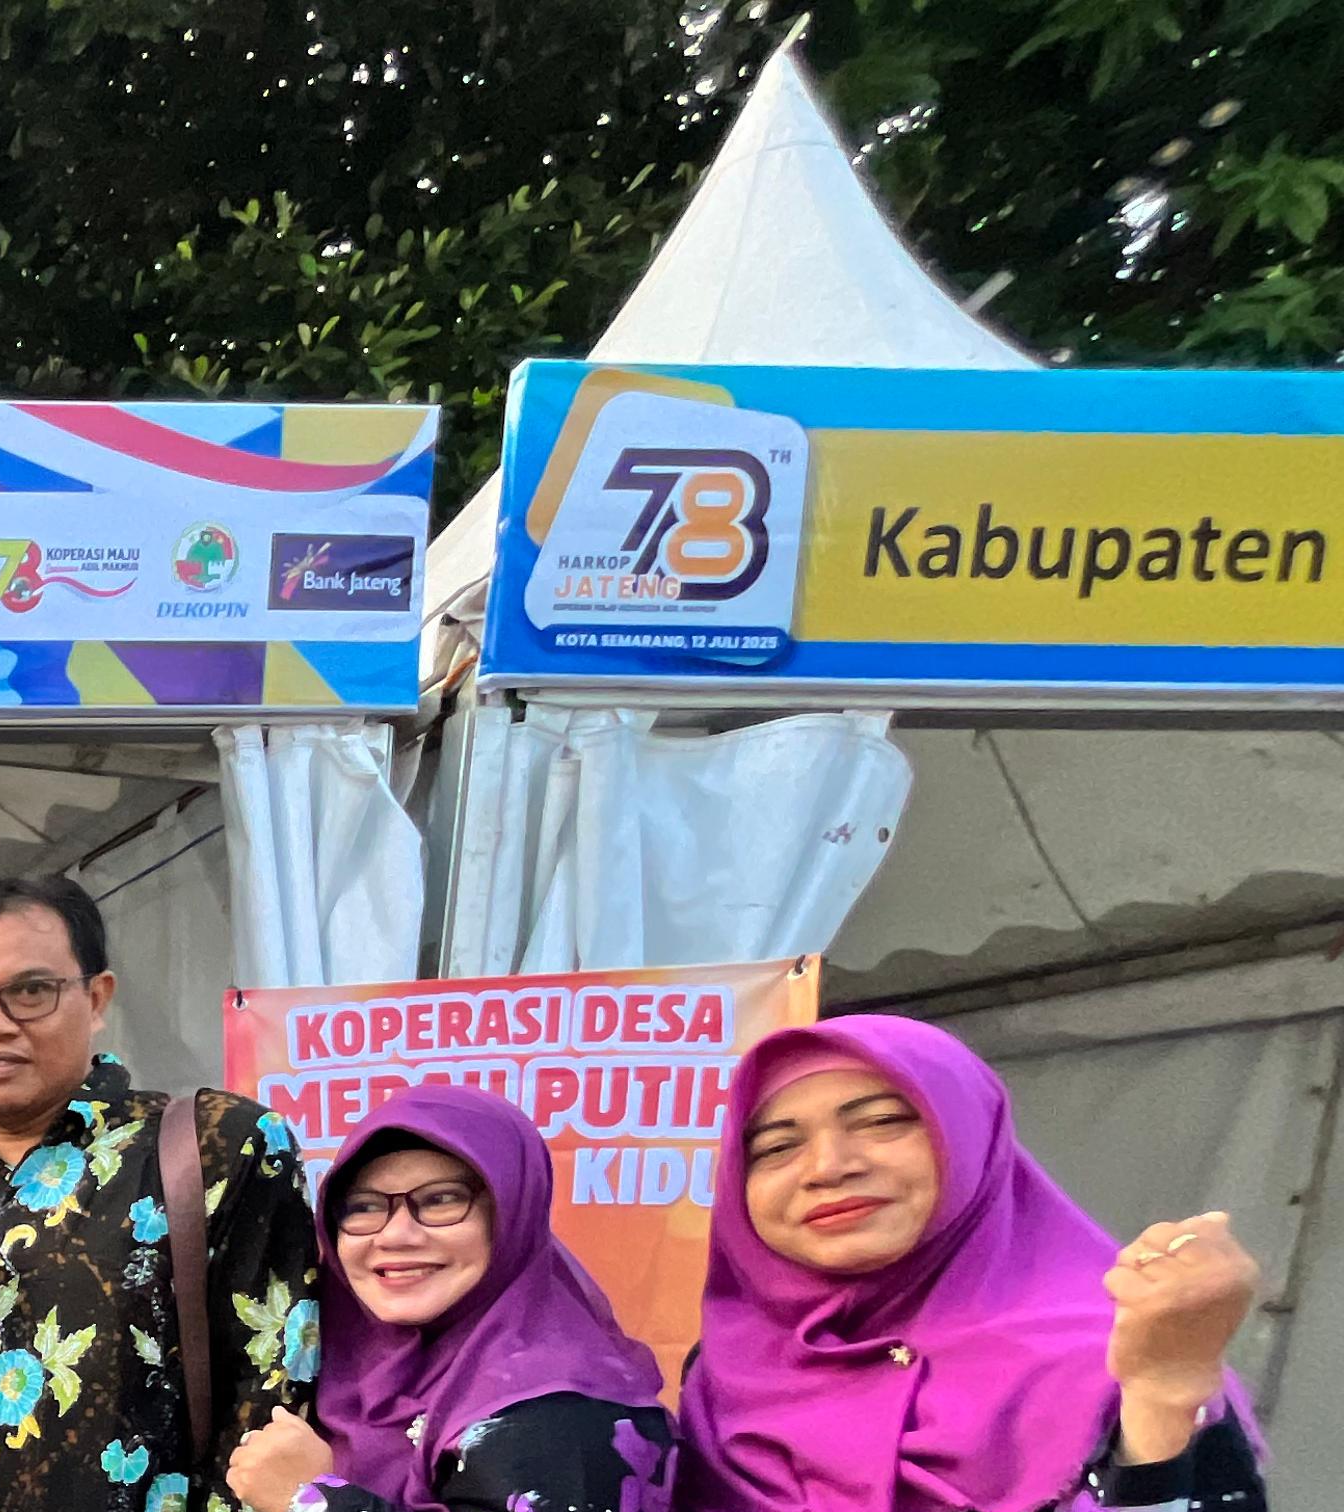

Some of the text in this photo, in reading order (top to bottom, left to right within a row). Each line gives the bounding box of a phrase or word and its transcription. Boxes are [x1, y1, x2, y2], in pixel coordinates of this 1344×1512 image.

[768, 449, 792, 464] TH
[602, 447, 772, 601] 78
[46, 547, 140, 561] KOPERASI MAJU
[863, 503, 1326, 599] Kabupaten
[558, 556, 631, 570] HARKOP
[303, 571, 402, 597] Bank Jateng
[554, 575, 682, 600] JATENG
[156, 601, 249, 618] DEKOPIN
[555, 633, 598, 647] KOTA
[691, 635, 706, 648] 12
[707, 635, 740, 649] JULI
[741, 636, 778, 649] 2025
[295, 993, 723, 1060] KOPERASI DESA
